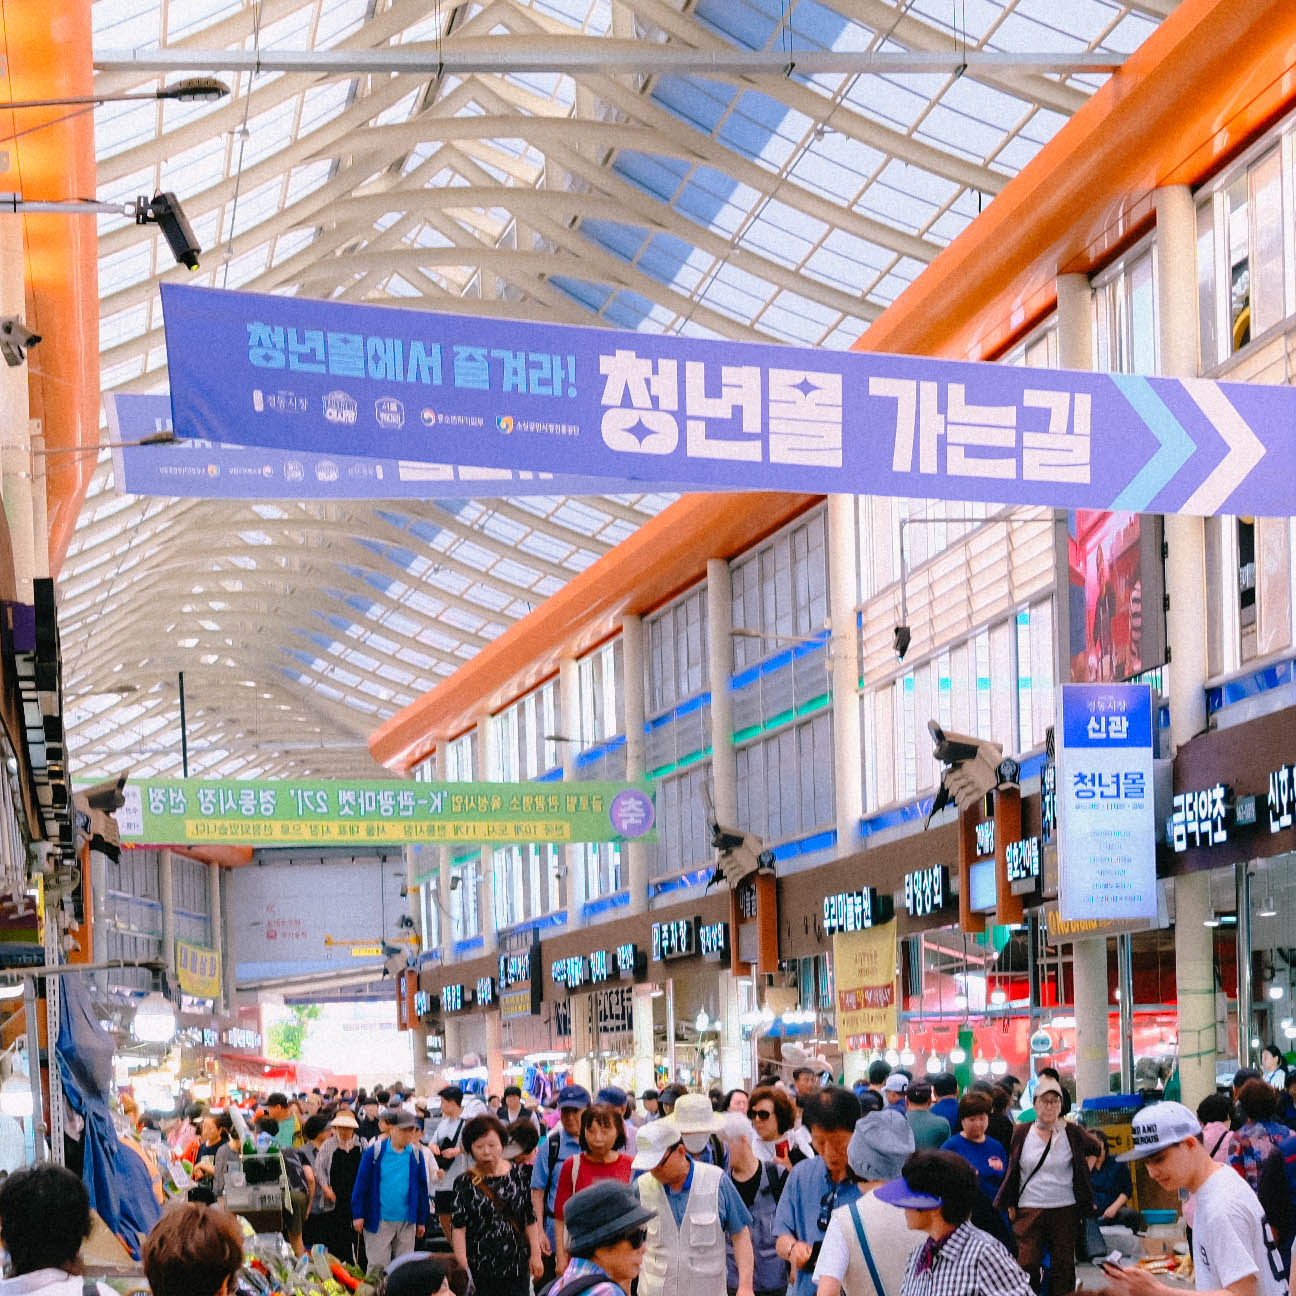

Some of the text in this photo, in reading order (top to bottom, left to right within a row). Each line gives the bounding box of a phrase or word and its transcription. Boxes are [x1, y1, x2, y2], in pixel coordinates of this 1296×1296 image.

[247, 321, 578, 399] 청년몰에서 즐겨라!
[599, 348, 1092, 484] 청년몰 가는길
[1087, 715, 1129, 740] 신관
[1073, 771, 1146, 800] 청년몰
[1172, 783, 1228, 853] 금덕약초
